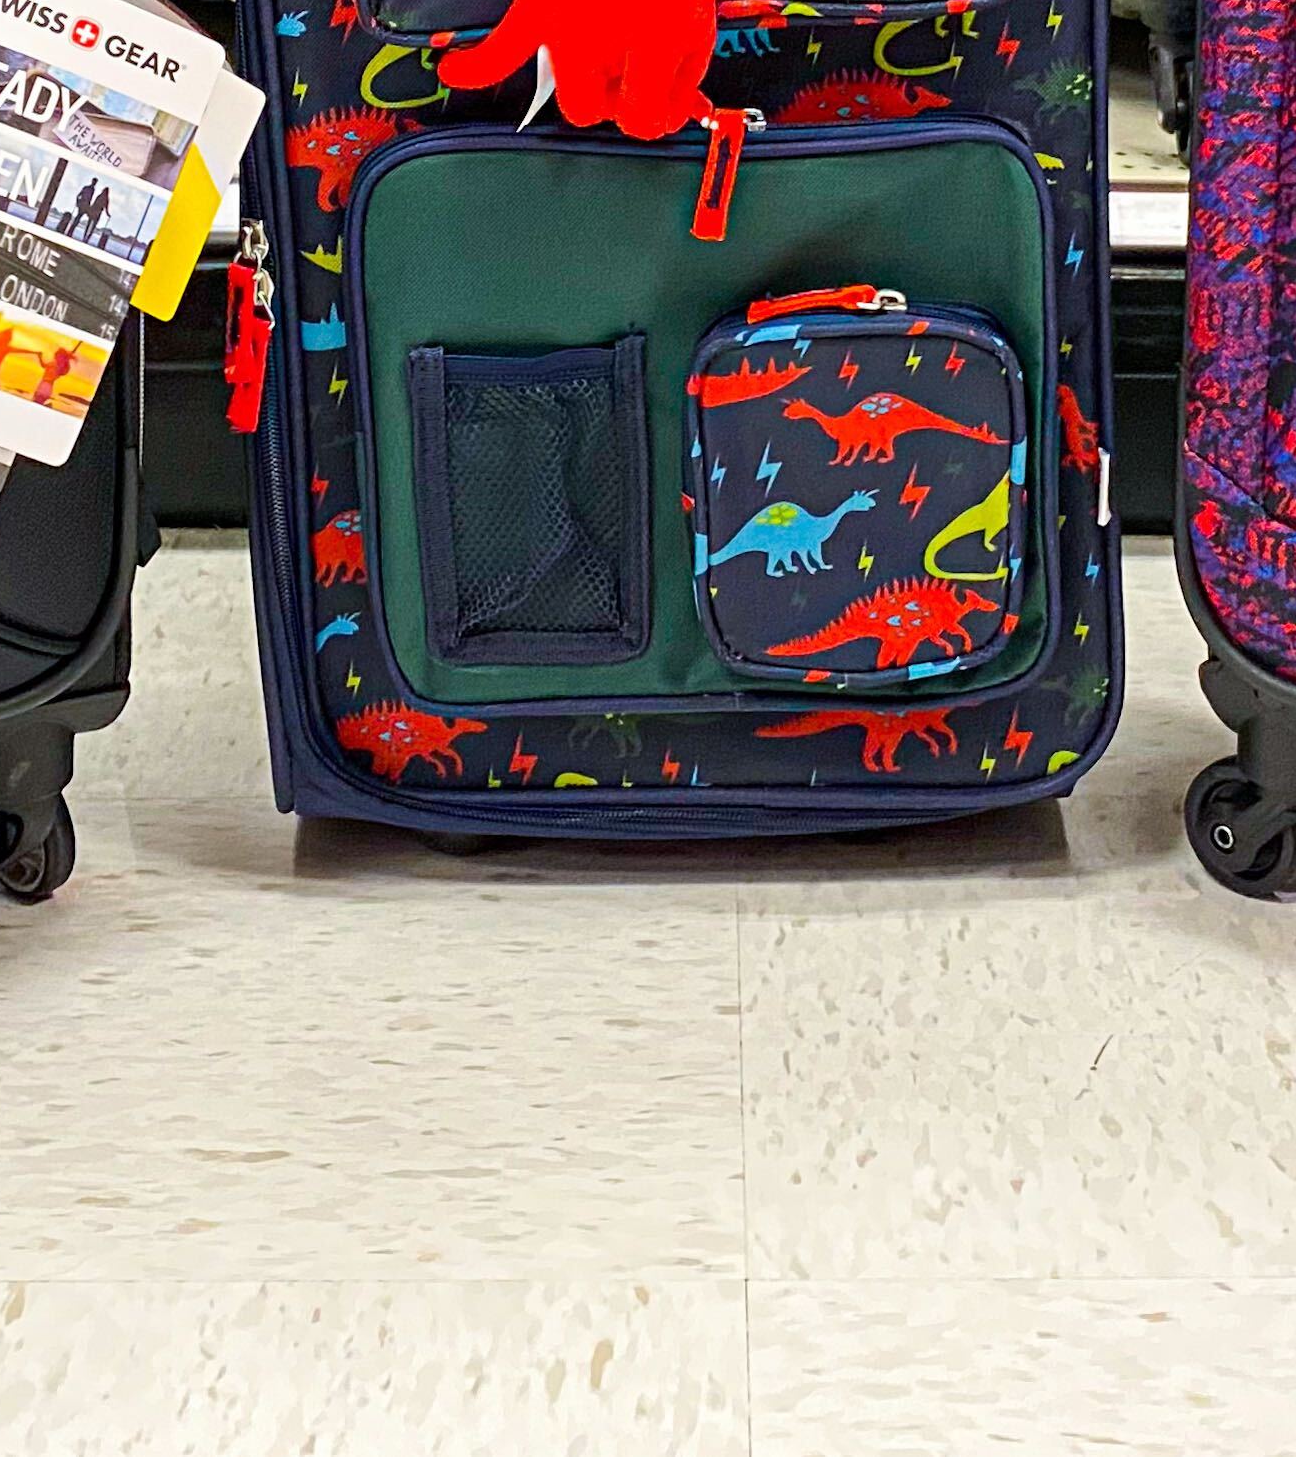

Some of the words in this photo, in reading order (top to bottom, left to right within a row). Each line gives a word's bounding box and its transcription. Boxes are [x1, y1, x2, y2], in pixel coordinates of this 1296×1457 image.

[104, 35, 180, 83] GEAR
[90, 133, 122, 168] WORLD
[0, 225, 62, 278] ROME
